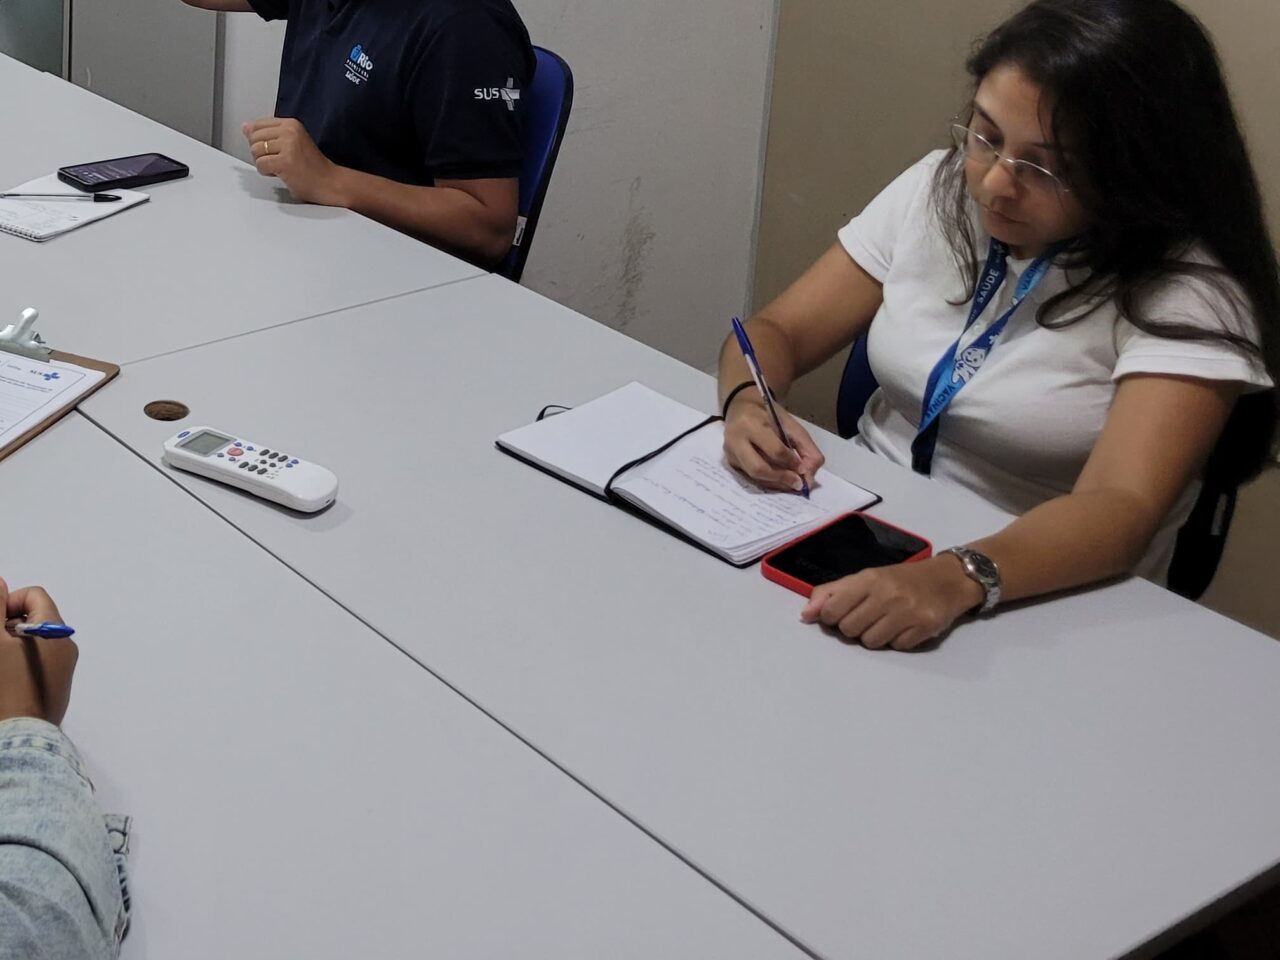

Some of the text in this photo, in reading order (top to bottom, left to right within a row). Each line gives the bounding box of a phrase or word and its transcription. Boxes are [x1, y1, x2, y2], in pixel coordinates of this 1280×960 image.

[357, 51, 373, 71] Rio
[473, 87, 499, 100] SUS
[976, 268, 999, 304] SAÚDE
